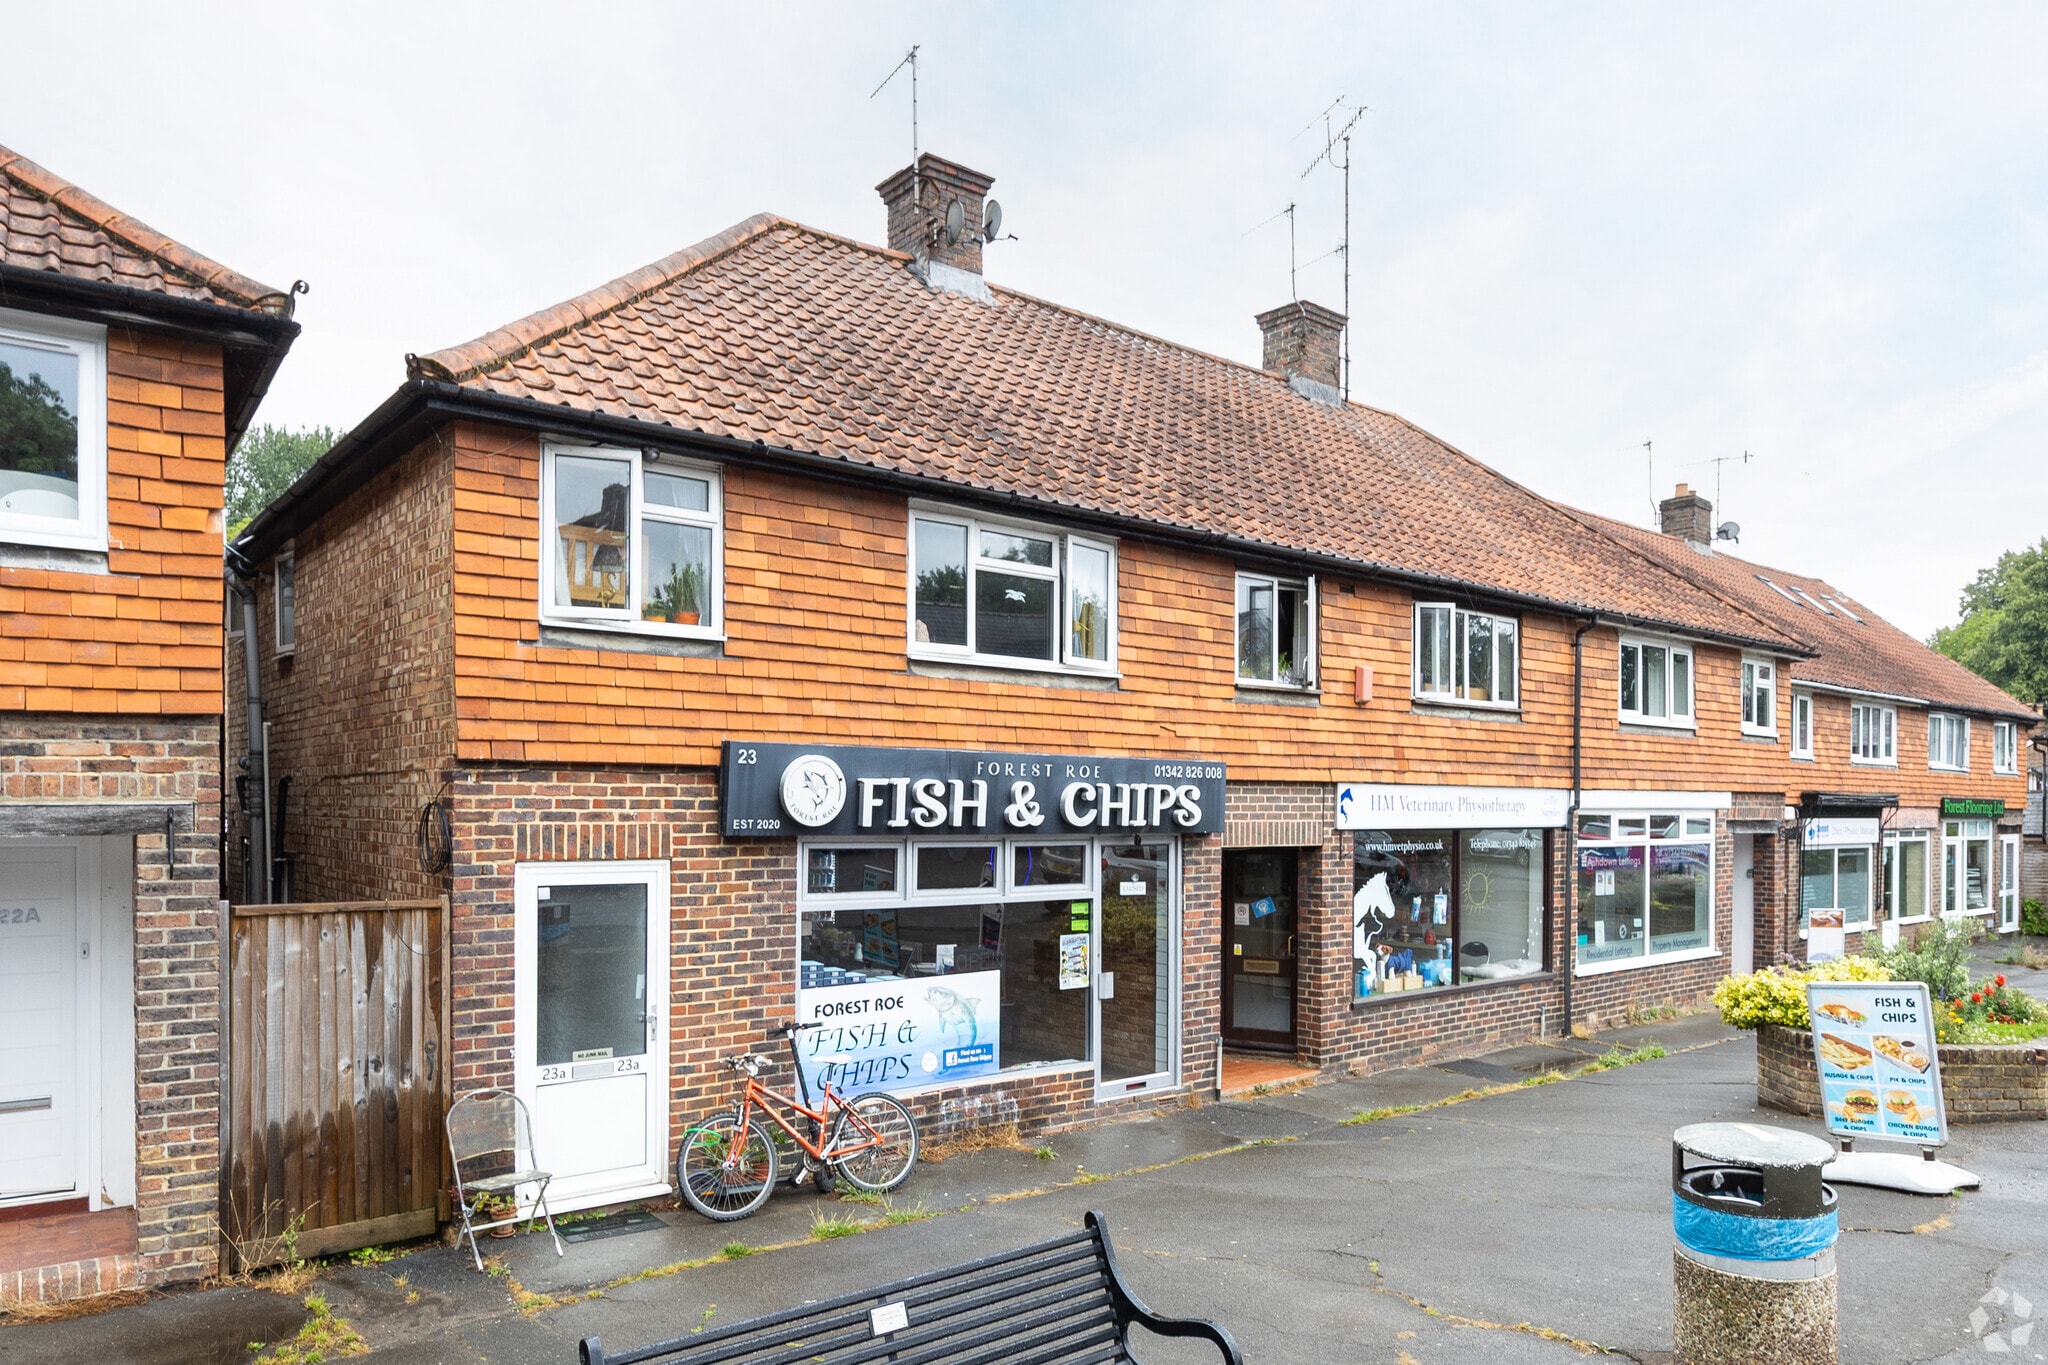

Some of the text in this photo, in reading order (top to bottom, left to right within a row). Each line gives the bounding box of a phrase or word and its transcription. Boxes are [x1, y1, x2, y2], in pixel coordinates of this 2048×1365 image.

[738, 749, 757, 765] 23
[977, 761, 1101, 779] FOREST ROE
[1154, 765, 1222, 779] 01342 826 008
[857, 777, 1202, 828] FISH & CHIPS
[1371, 794, 1394, 811] HM
[1399, 795, 1454, 817] Veterinary
[1458, 797, 1526, 817] Physiotherapy
[1944, 799, 2004, 818] Forest Flooring Ltd
[733, 819, 781, 829] EST 2020
[1365, 838, 1443, 854] www.hmvetphysio.co.uk
[1586, 857, 1641, 868] Ashdown Lettings
[0, 907, 41, 924] 22A
[1652, 937, 1702, 950] Property Management
[1586, 945, 1633, 959] Residential Lettings
[815, 996, 904, 1018] FOREST ROE
[1875, 997, 1916, 1008] FISH &
[1881, 1012, 1917, 1023] CHIPS
[809, 1020, 920, 1056] FISH &
[617, 1059, 640, 1071] 23a
[542, 1067, 566, 1080] 23a
[816, 1054, 912, 1091] CHIPS
[1850, 1118, 1875, 1126] BURGER
[1887, 1121, 1914, 1130] CHICKEN
